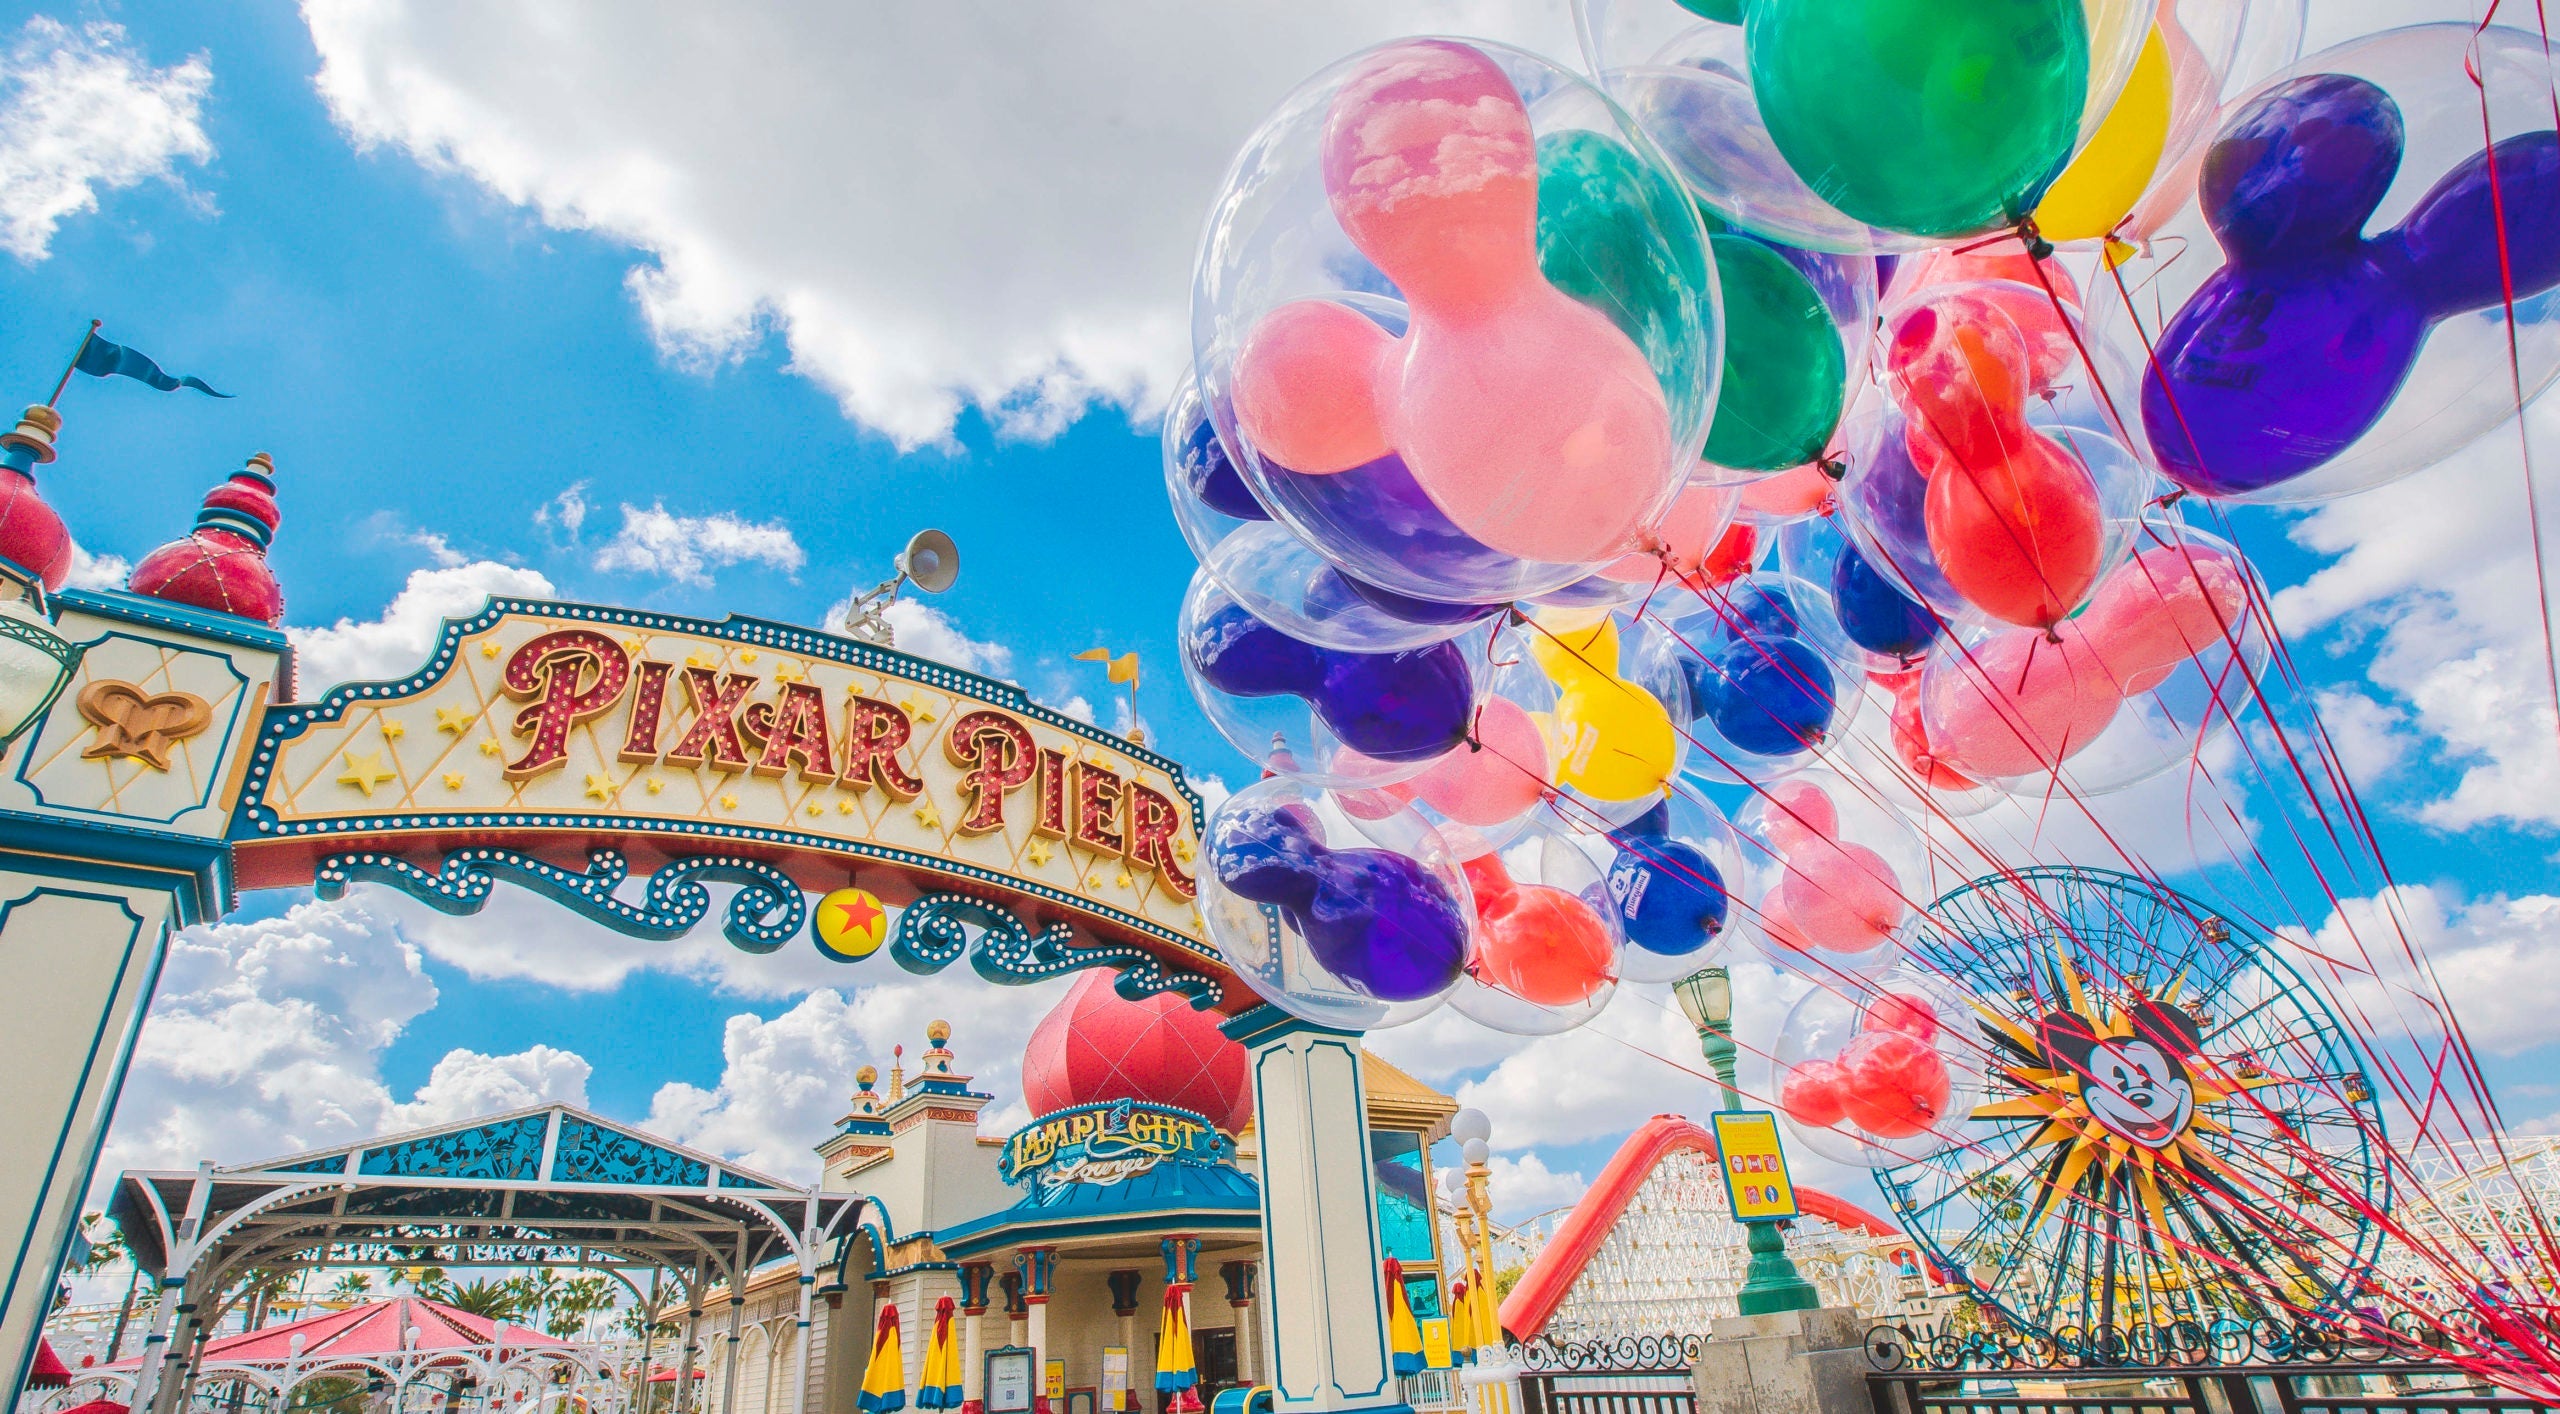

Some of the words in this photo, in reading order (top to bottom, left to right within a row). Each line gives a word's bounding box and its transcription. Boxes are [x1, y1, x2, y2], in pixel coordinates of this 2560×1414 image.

[502, 628, 924, 803] PIXAR
[943, 709, 1197, 904] PIER
[1625, 873, 1647, 918] Disneyland
[1041, 1154, 1163, 1187] Lounge
